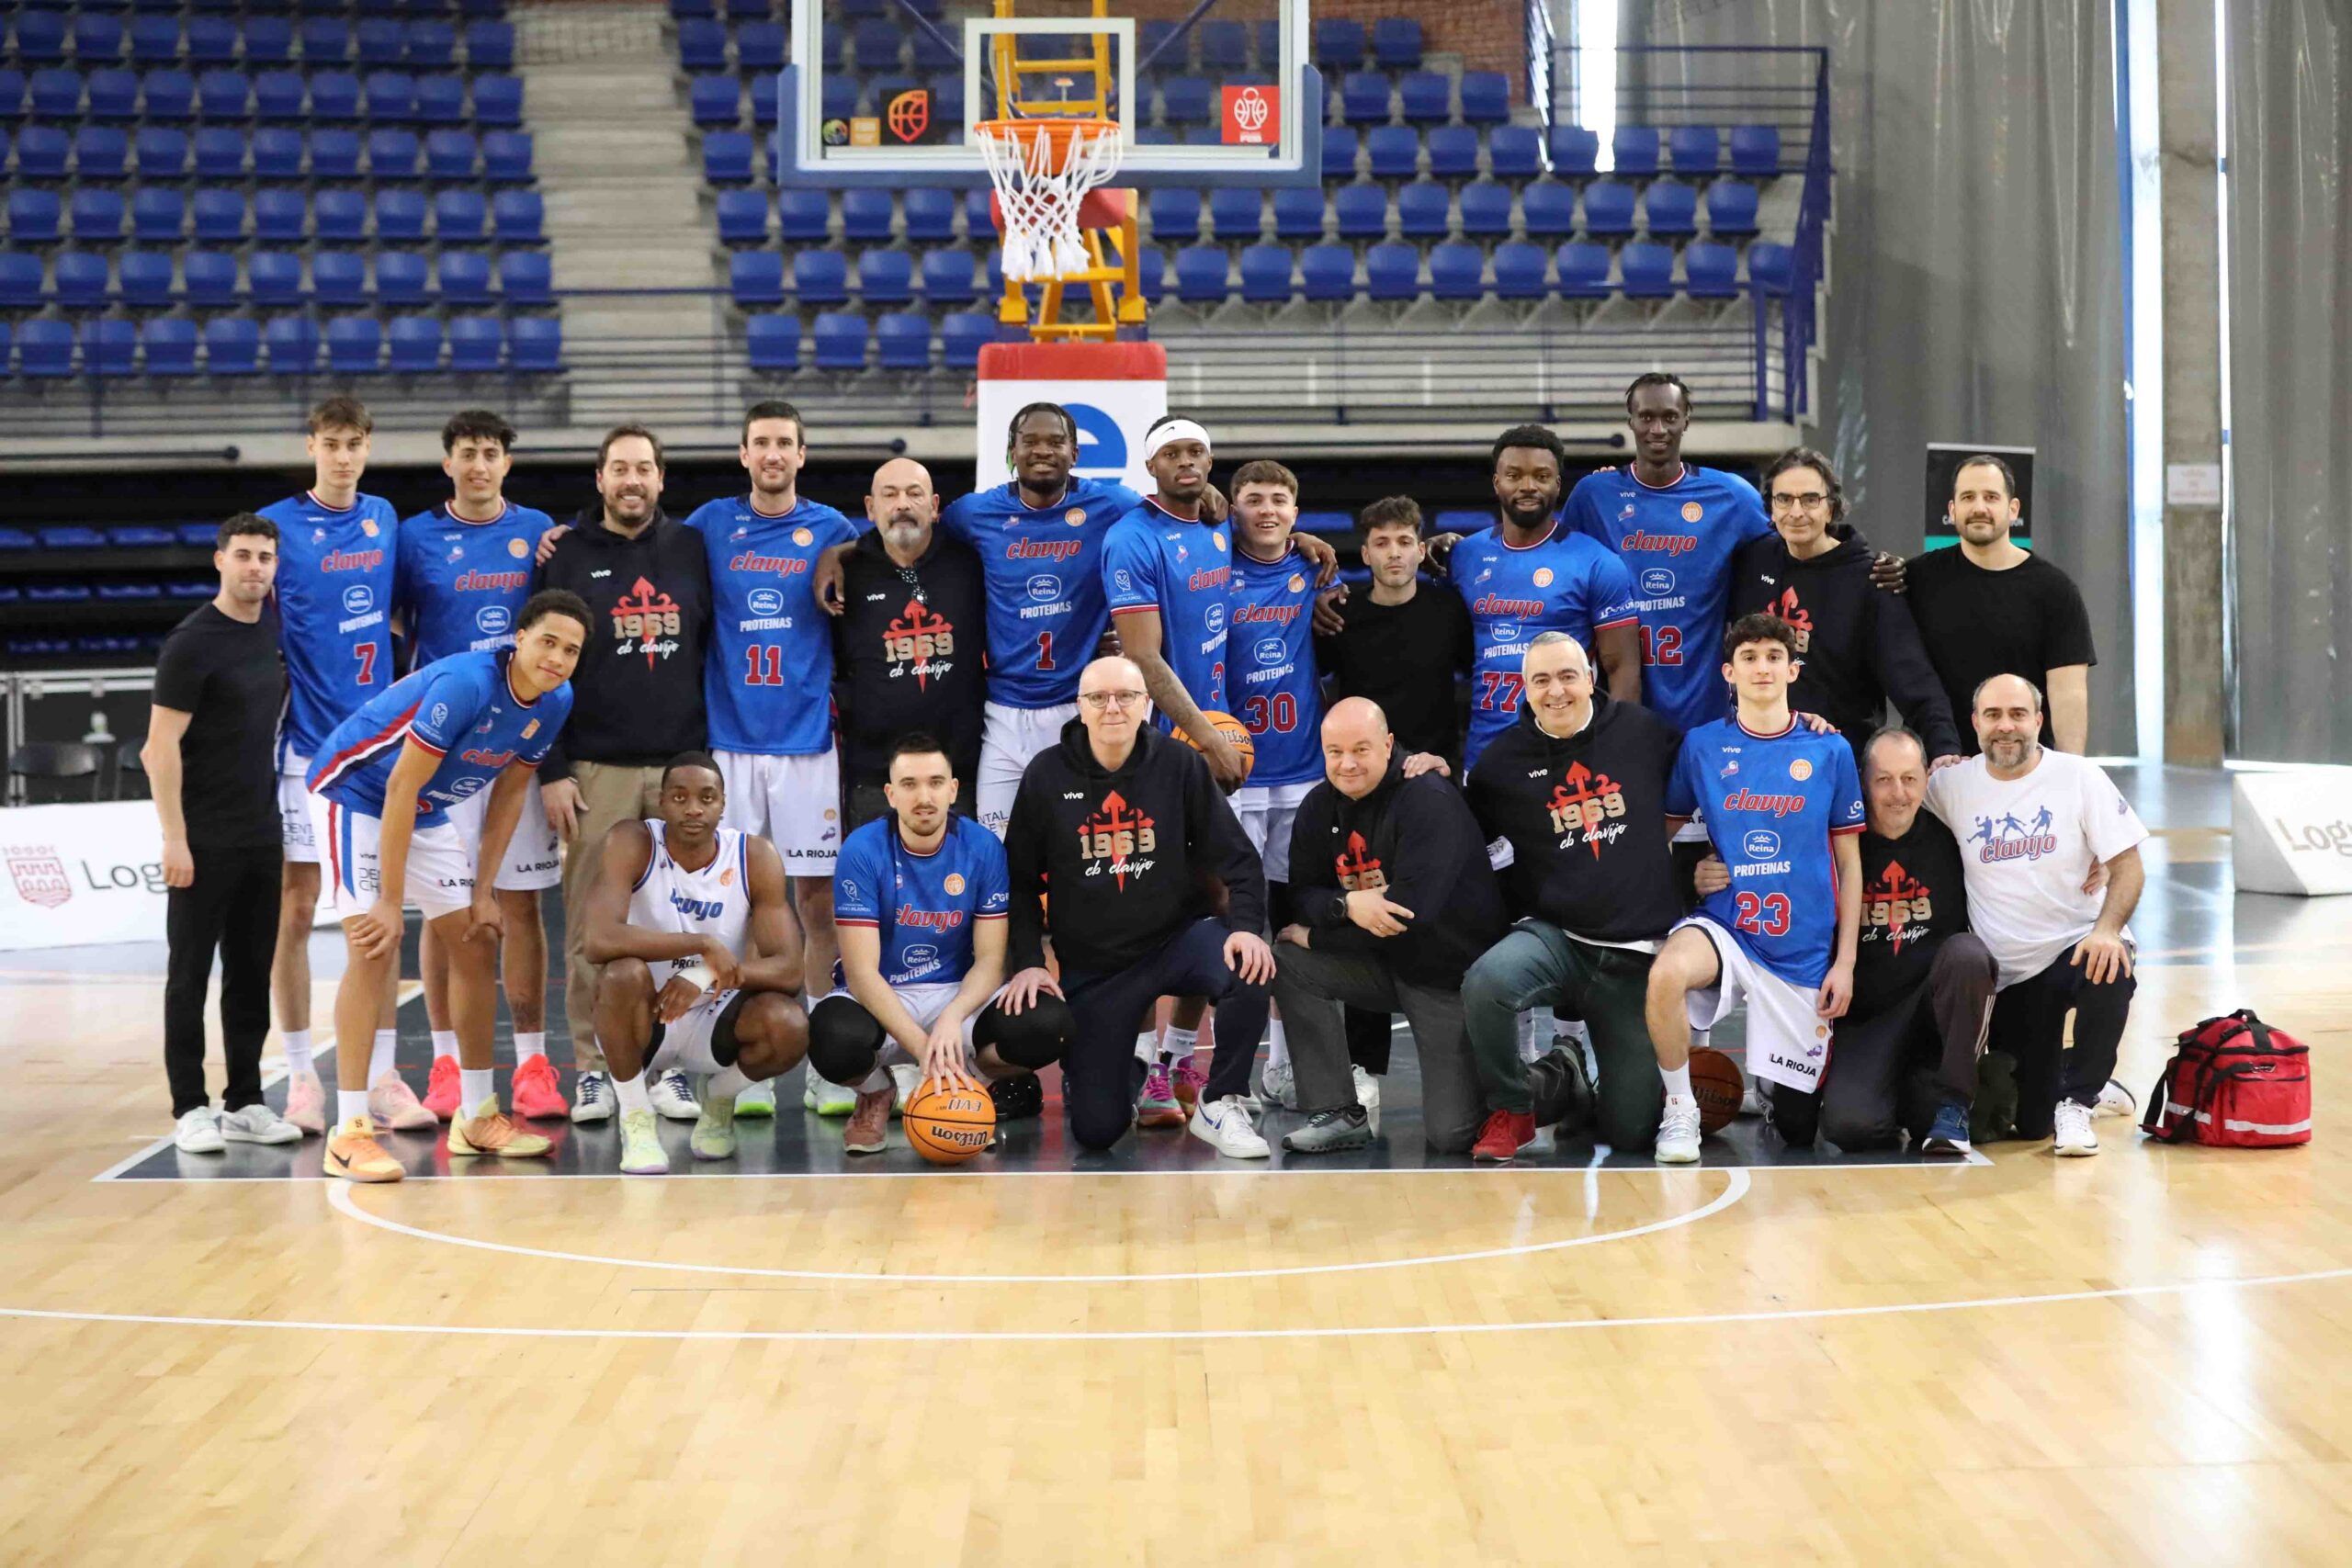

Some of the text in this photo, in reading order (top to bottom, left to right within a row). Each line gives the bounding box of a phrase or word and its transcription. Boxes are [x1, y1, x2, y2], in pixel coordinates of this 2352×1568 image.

[1166, 533, 1182, 541] vive
[1032, 588, 1057, 596] Reina
[1645, 581, 1670, 590] Reina
[752, 602, 778, 611] Reina
[866, 593, 886, 602] vive
[1635, 596, 1686, 612] PROTEINAS
[1020, 601, 1072, 619] PROTEINAS
[613, 612, 681, 639] 1969
[740, 616, 793, 632] PROTEINAS
[1494, 627, 1516, 636] Reina
[885, 632, 954, 663] 1969
[1036, 631, 1056, 671] 1
[1484, 643, 1530, 659] PROTEINAS
[1639, 625, 1683, 666] 12
[354, 642, 378, 685] 7
[1259, 650, 1283, 660] Reina
[745, 644, 784, 686] 11
[910, 659, 954, 681] clavijo
[1480, 671, 1525, 713] 77
[1244, 692, 1297, 735] 30
[1722, 746, 1741, 754] vive
[1529, 769, 1548, 778] vive
[1064, 791, 1084, 801] vive
[1550, 792, 1626, 834] 1969
[1080, 828, 1156, 860] 1969
[1559, 823, 1628, 850] cb clavijo
[2275, 818, 2352, 858] Log
[788, 850, 839, 859] LA RIOJA
[1748, 843, 1774, 853] Reina
[516, 864, 532, 873] LA
[1085, 858, 1156, 880] cb clavijo
[1734, 861, 1791, 877] PROTEINAS
[440, 879, 457, 887] LA
[1338, 868, 1387, 892] 969
[1735, 891, 1792, 936] 23
[1860, 897, 1933, 927] 1969
[1862, 926, 1931, 944] cb clavijo
[1770, 1054, 1816, 1077] LA RIOJA
[948, 1099, 982, 1111] EVO
[932, 1125, 988, 1147] Wilson
